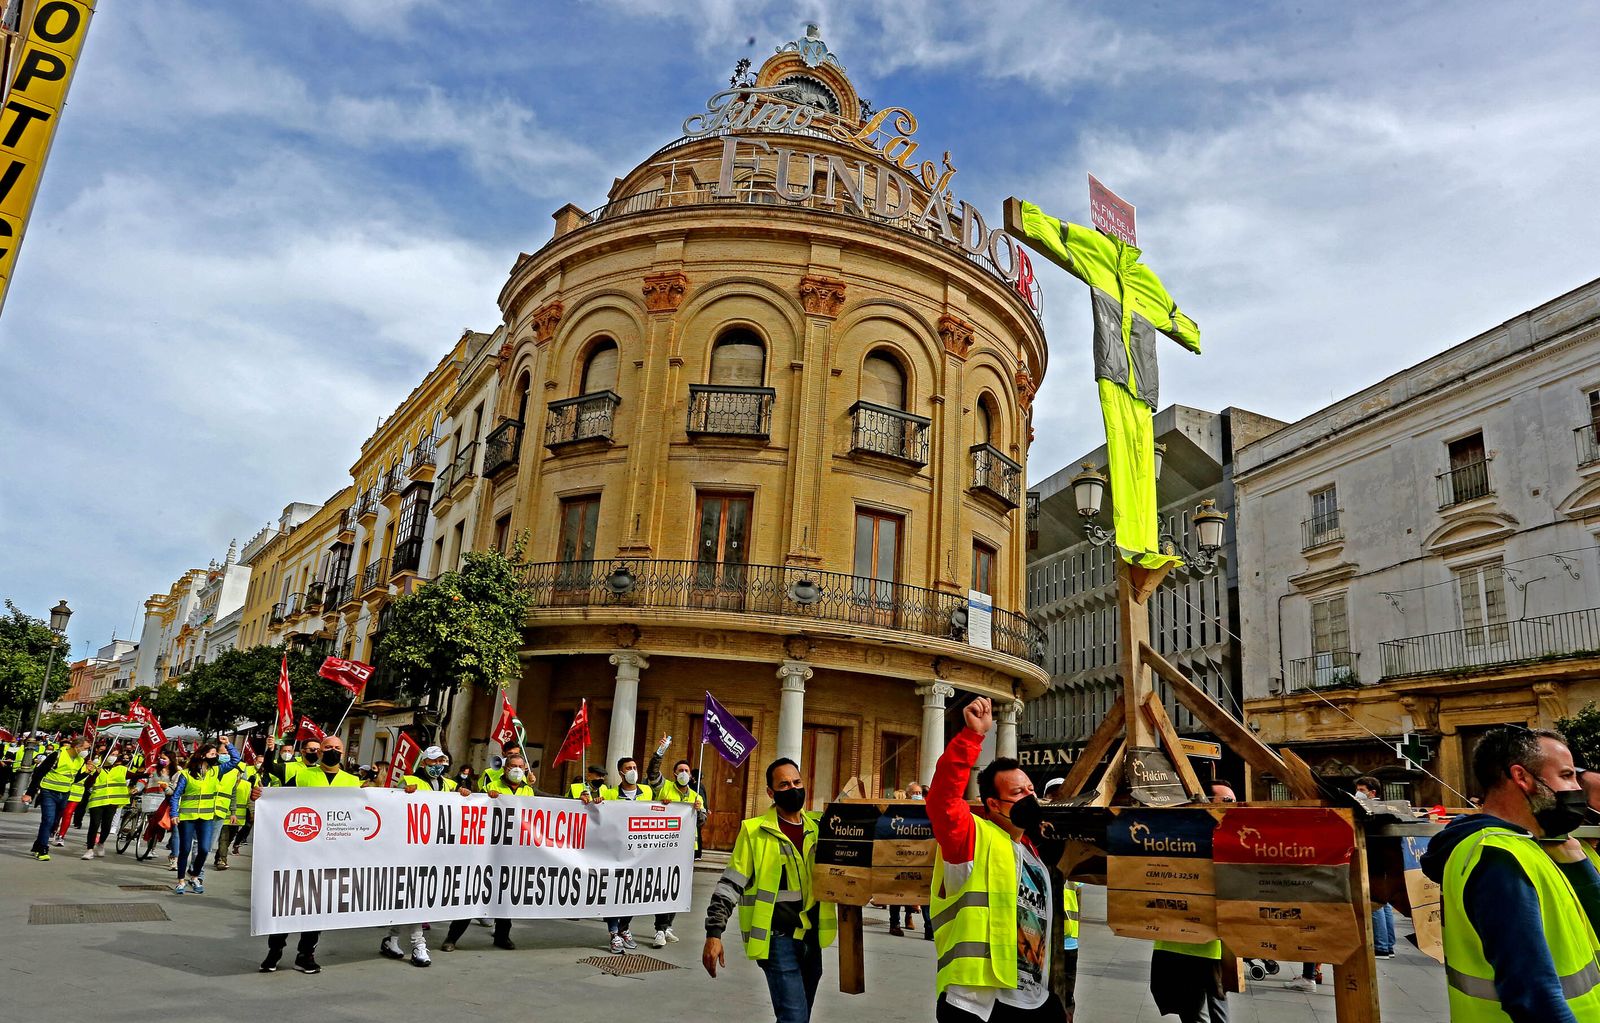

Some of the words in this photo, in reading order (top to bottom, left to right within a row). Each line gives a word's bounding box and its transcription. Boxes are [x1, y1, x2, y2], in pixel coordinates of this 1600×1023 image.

[682, 84, 825, 137] Fino
[830, 107, 918, 170] La
[712, 136, 1038, 311] FUNDADOR
[1091, 199, 1100, 211] AL
[1101, 204, 1115, 222] FIN
[1116, 218, 1126, 231] DE
[1126, 225, 1136, 237] LA
[1091, 209, 1136, 246] INDUSTRIA
[288, 812, 318, 827] UGT
[326, 811, 352, 821] FICA
[631, 818, 667, 829] CCOO
[407, 803, 431, 844] NO
[436, 805, 455, 845] AL
[459, 806, 488, 845] ERE
[490, 807, 515, 845] DE
[519, 808, 588, 849] HOLCIM
[834, 825, 864, 837] Holcim
[896, 824, 931, 836] Holcim
[628, 832, 680, 841] construcción
[628, 842, 633, 851] y
[637, 841, 679, 849] servicios
[1143, 837, 1197, 853] Holcim
[1254, 842, 1316, 858] Holcim
[1178, 872, 1192, 880] 32,5
[272, 866, 438, 917] MANTENIMIENTO
[441, 866, 462, 907] DE
[464, 865, 493, 906] LOS
[497, 865, 581, 906] PUESTOS
[585, 867, 609, 905] DE
[614, 865, 681, 905] TRABAJO
